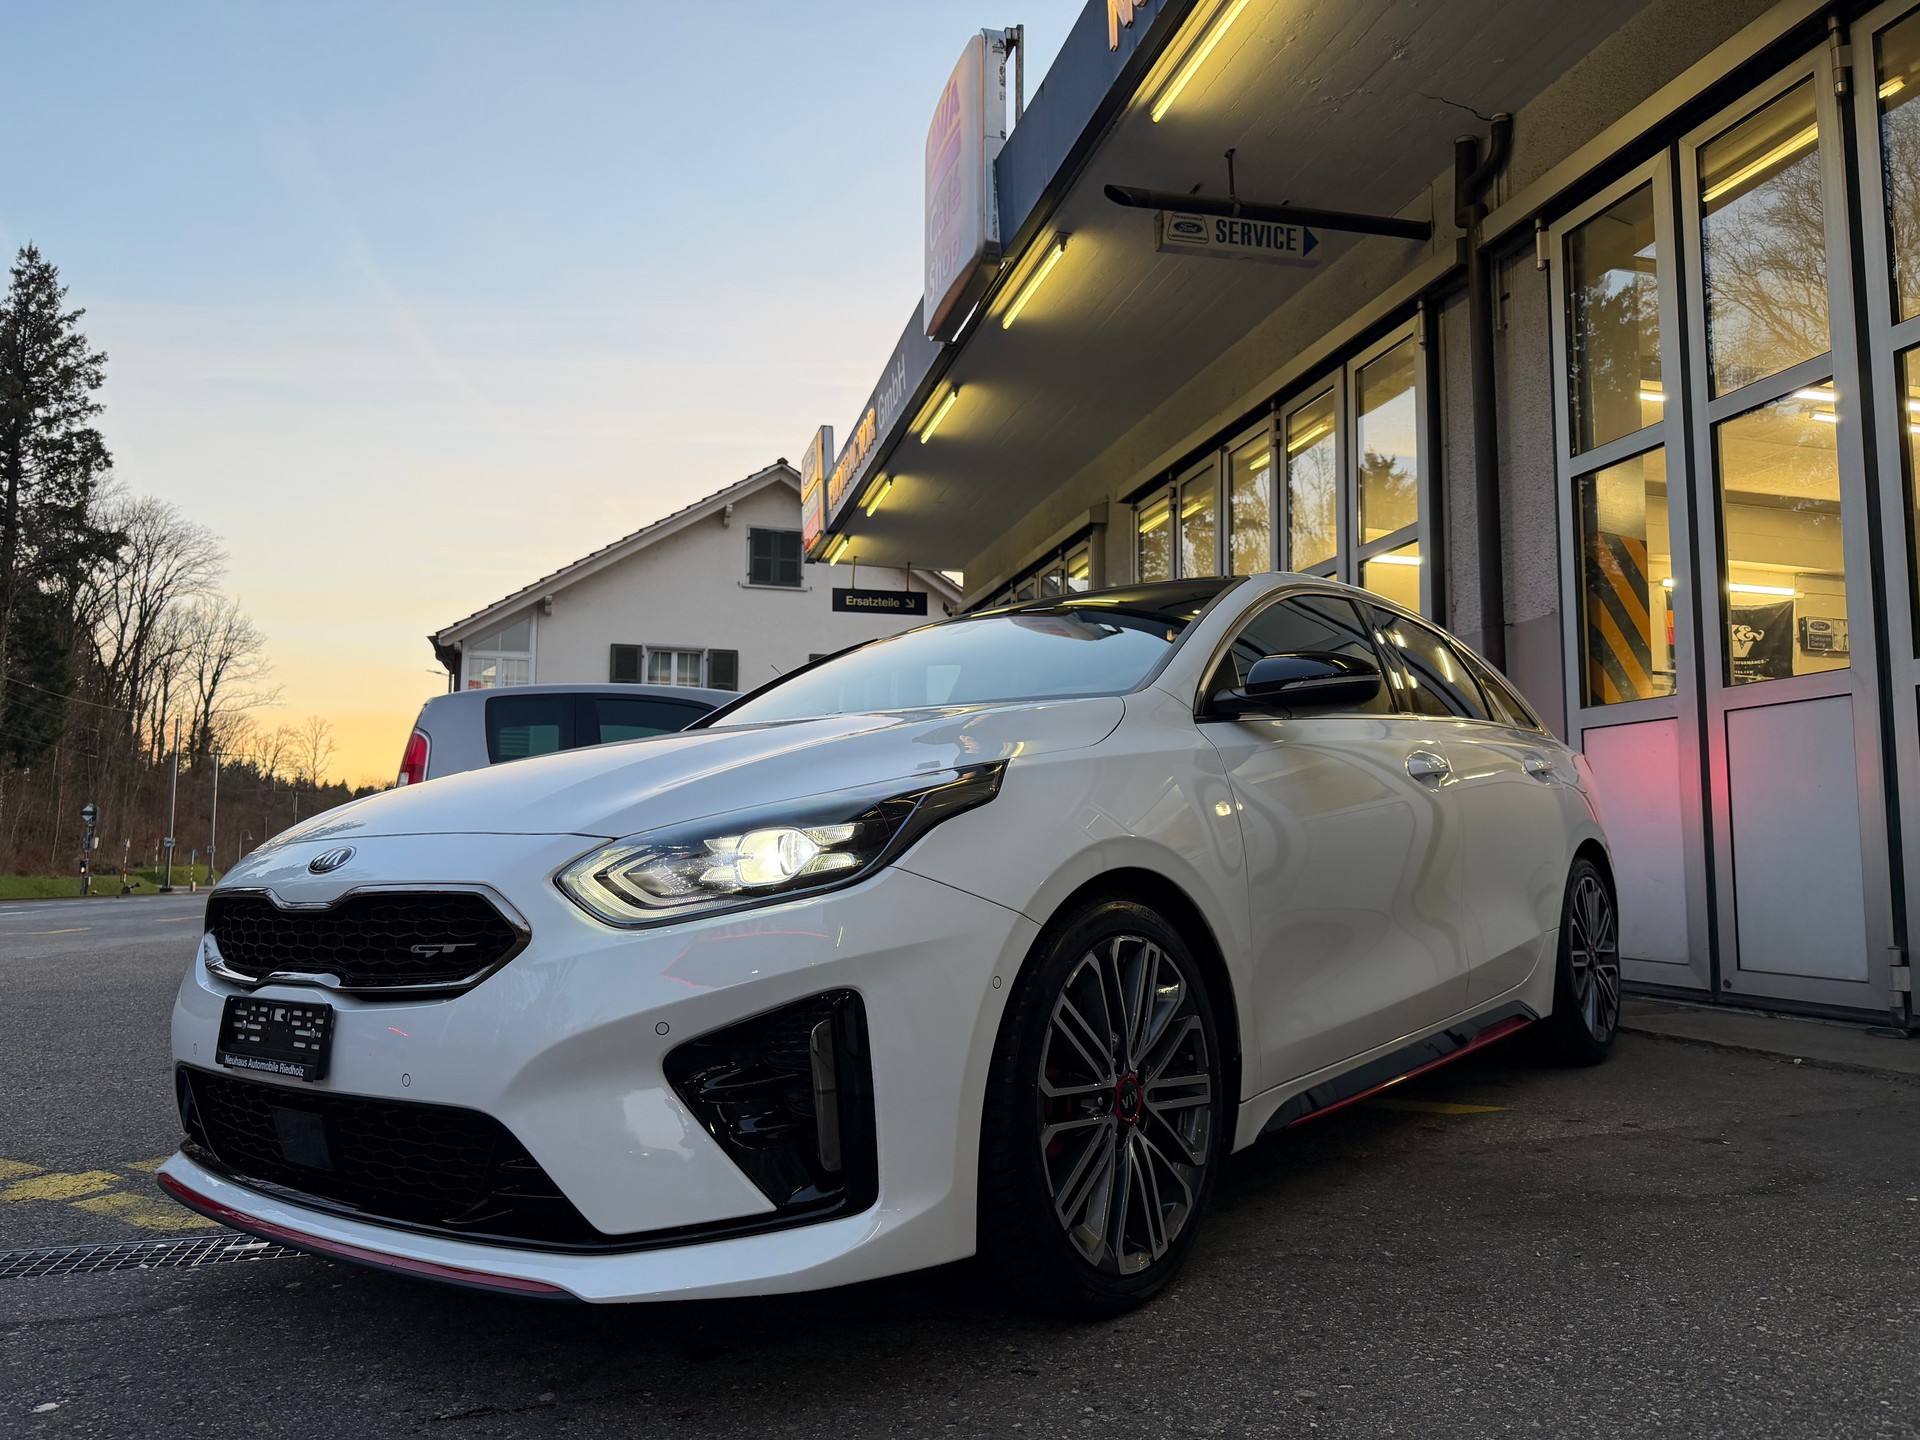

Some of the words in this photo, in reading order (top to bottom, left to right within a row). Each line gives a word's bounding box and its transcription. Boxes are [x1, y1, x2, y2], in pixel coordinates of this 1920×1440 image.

[1215, 219, 1297, 251] SERVICE
[877, 353, 907, 430] GmbH
[846, 596, 900, 607] Ersatzteile
[410, 943, 477, 958] GT
[225, 1055, 247, 1067] Neuhaus
[248, 1059, 278, 1072] Automobile
[280, 1063, 304, 1076] Riedholz
